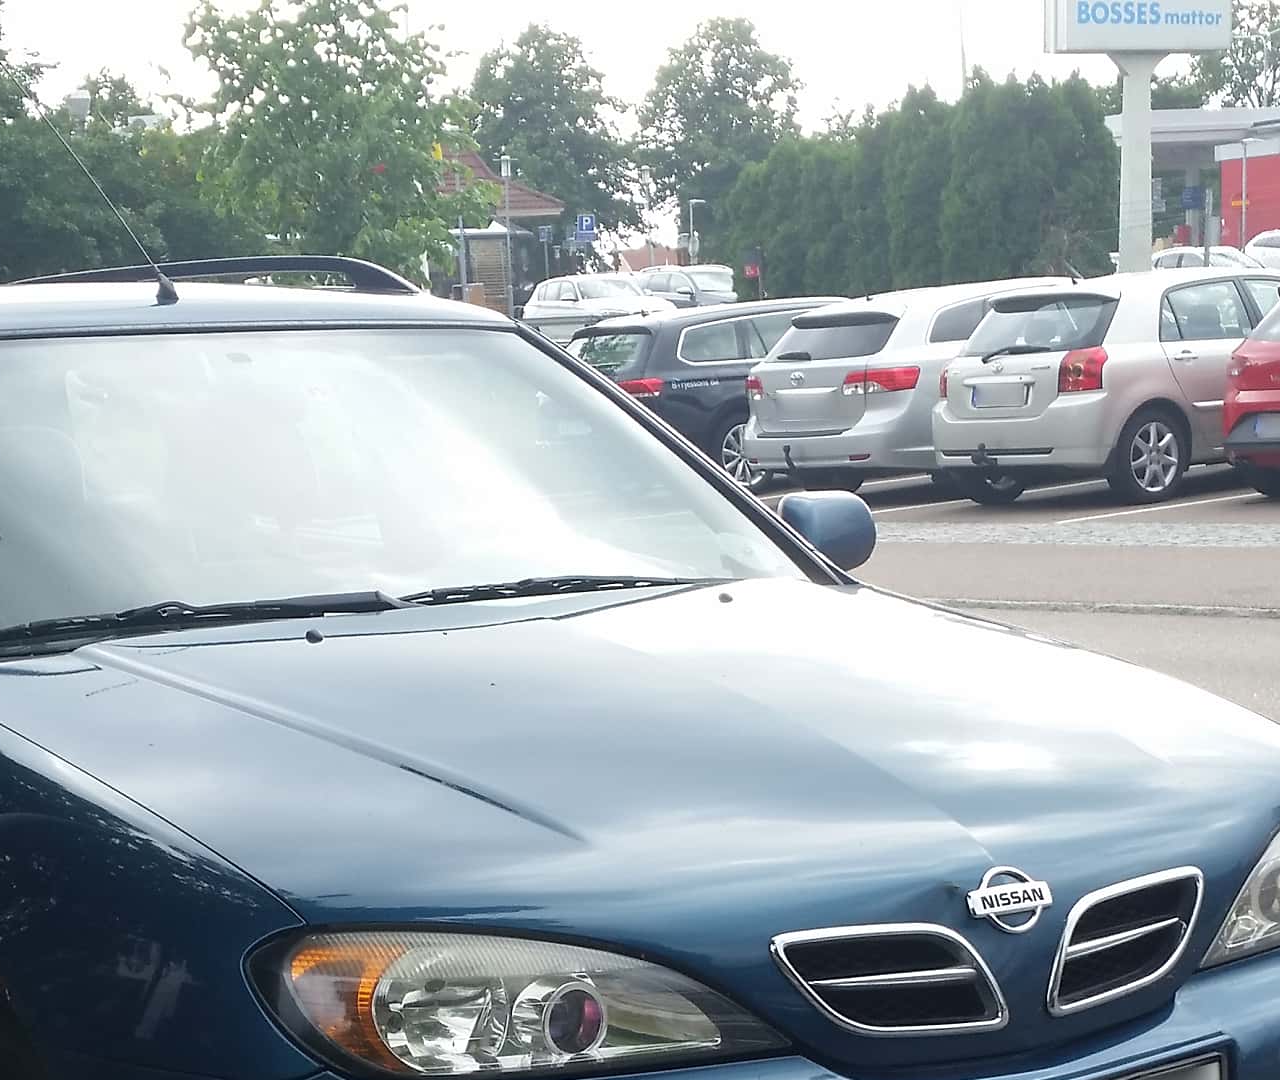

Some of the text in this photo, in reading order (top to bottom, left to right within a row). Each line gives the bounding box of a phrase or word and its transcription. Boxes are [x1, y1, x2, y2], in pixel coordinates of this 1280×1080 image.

[1077, 2, 1221, 25] BOSSES mattor
[583, 217, 592, 230] P
[981, 887, 1045, 909] NISSAN
